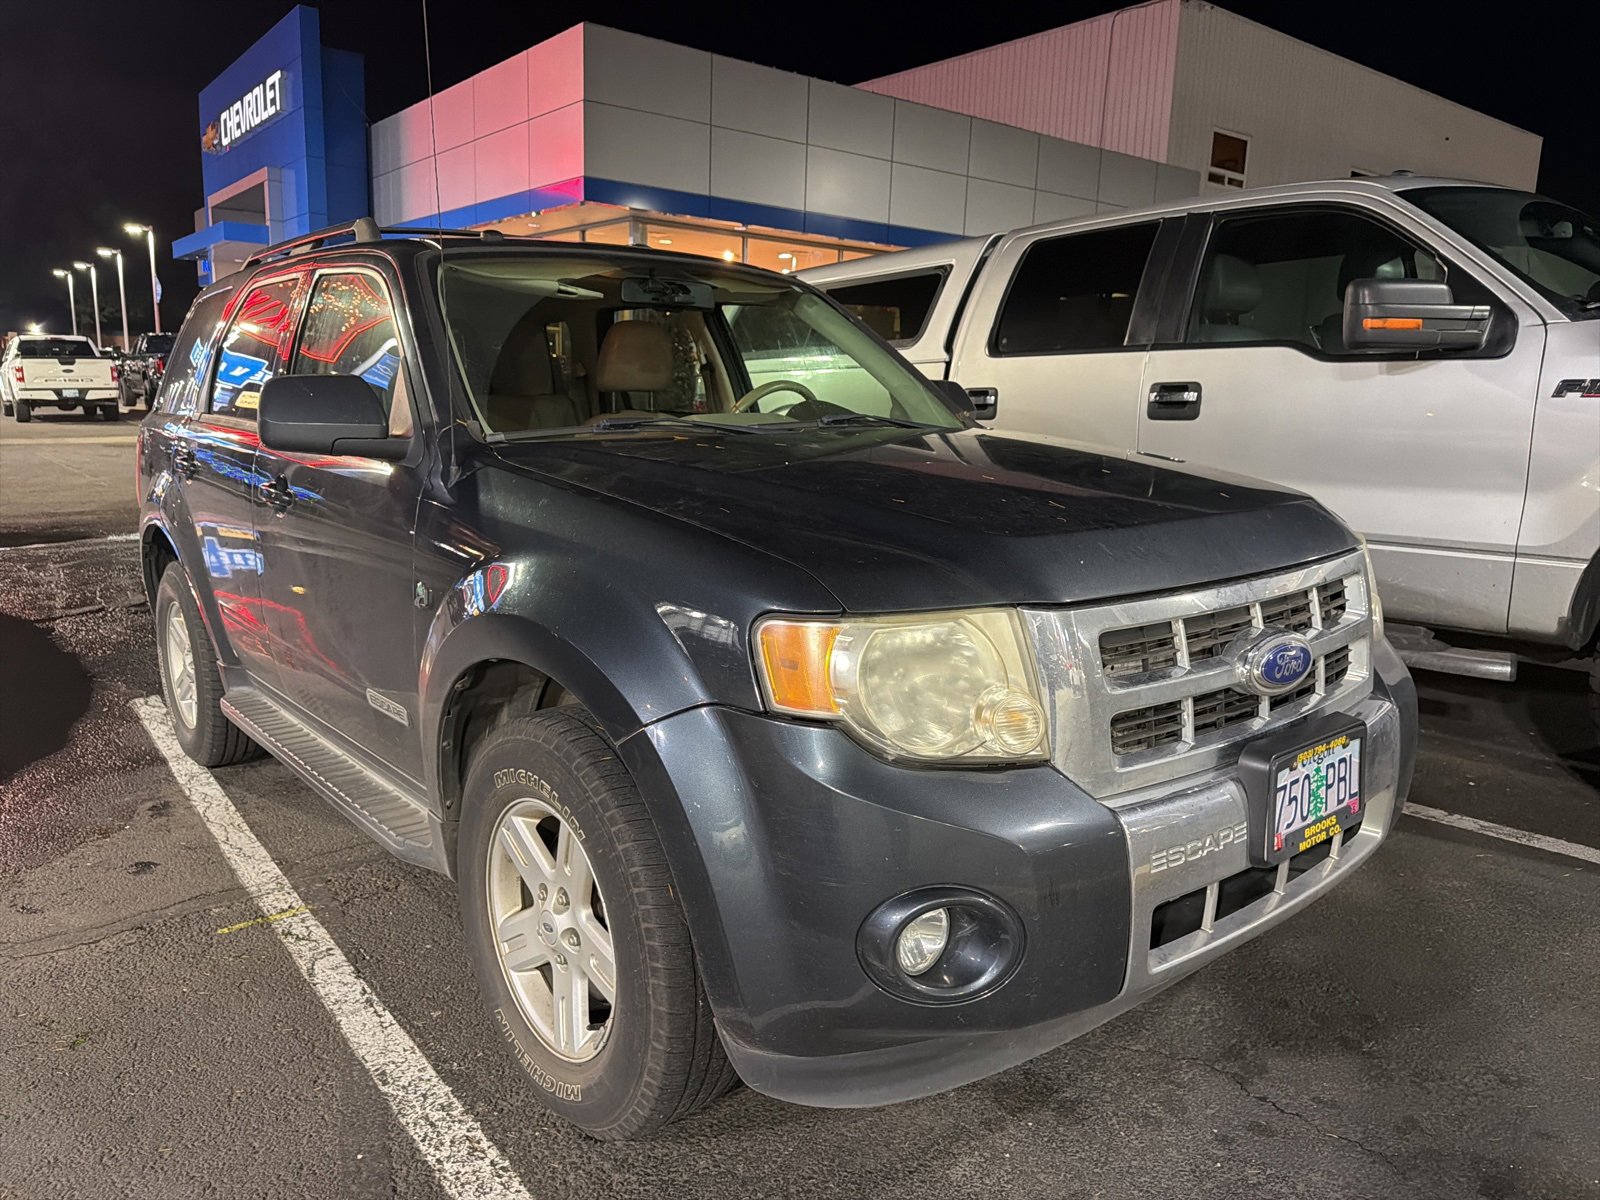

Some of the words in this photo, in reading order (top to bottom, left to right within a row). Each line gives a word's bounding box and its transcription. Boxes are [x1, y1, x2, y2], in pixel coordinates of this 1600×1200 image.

[220, 69, 282, 147] CHEVROLET
[1275, 649, 1304, 679] Ford
[493, 767, 587, 842] MICHELIN
[1275, 773, 1312, 834] 750
[1325, 753, 1359, 812] PBL
[1150, 820, 1248, 874] ESCAPE
[1299, 830, 1328, 853] MOTOR
[1328, 824, 1342, 837] CO.
[1304, 815, 1337, 839] BROOKS
[493, 1007, 582, 1101] MICHELIN
